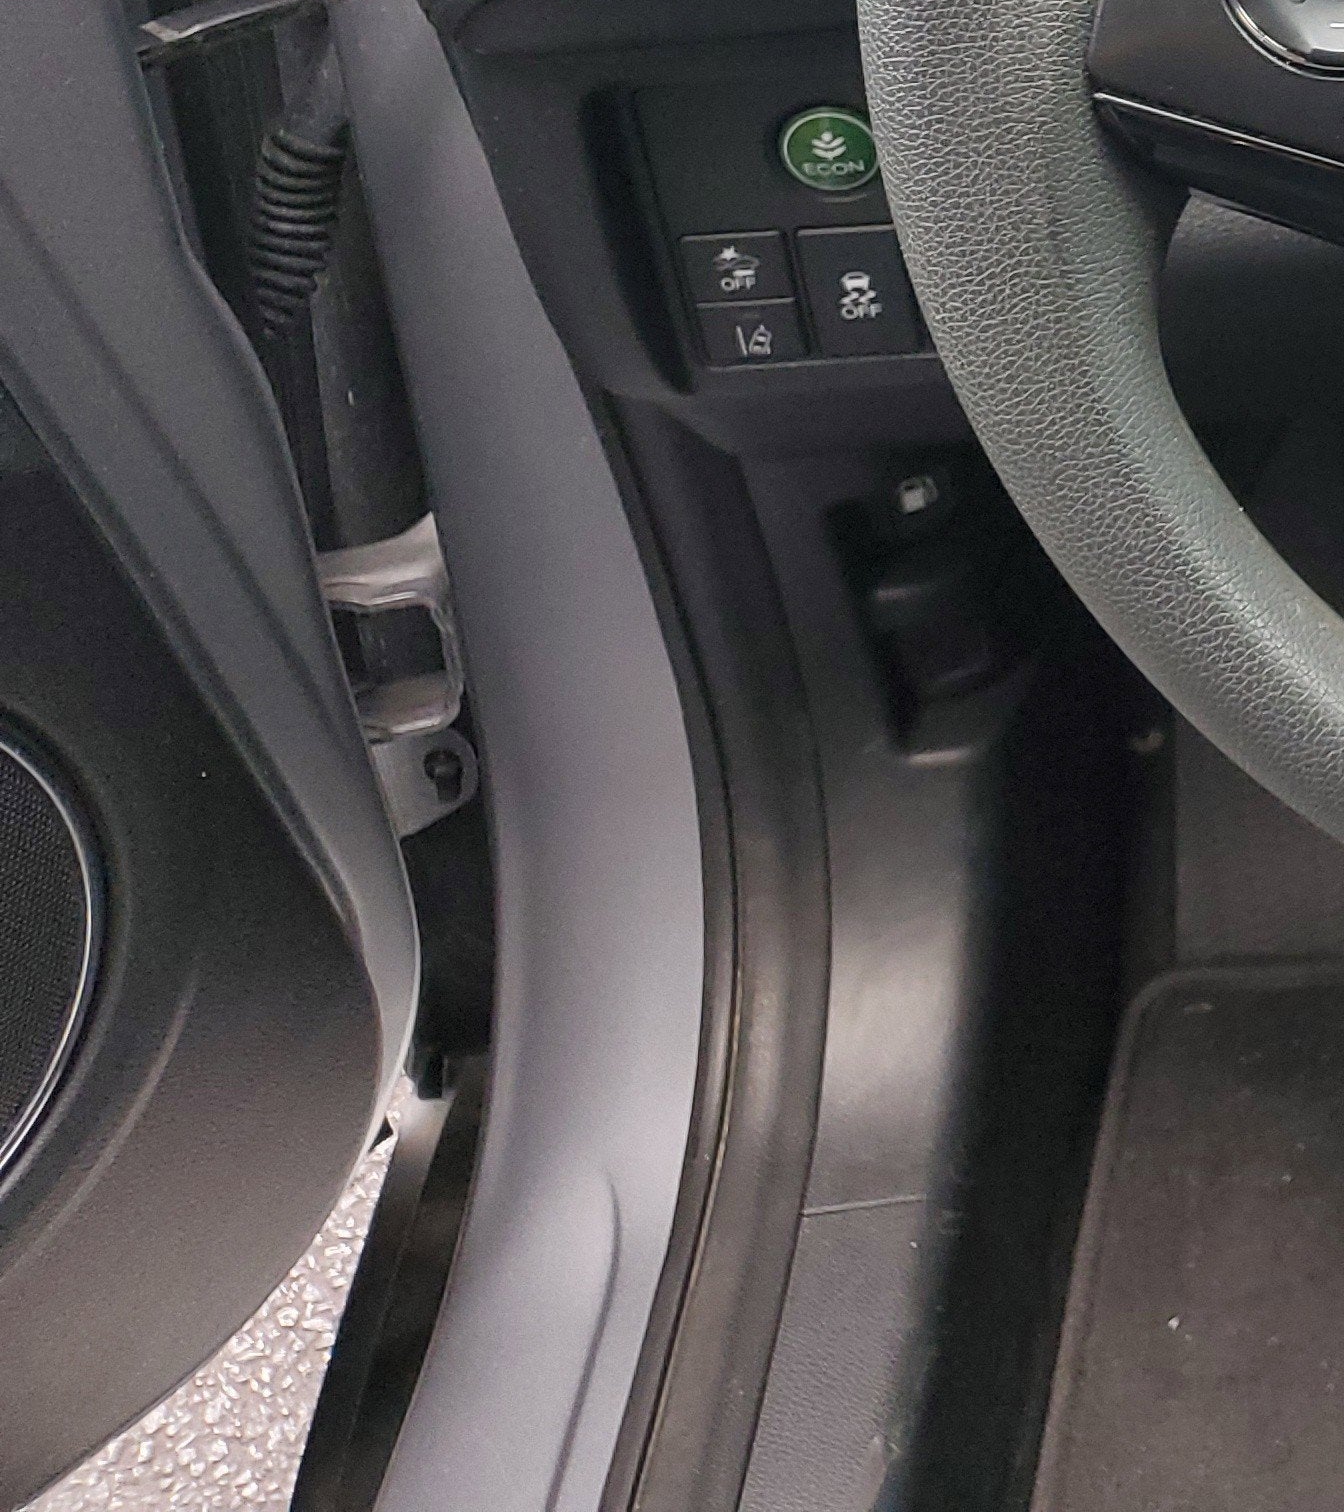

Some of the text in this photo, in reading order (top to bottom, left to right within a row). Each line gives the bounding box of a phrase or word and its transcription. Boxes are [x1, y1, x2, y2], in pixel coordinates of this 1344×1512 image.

[801, 159, 865, 176] ECON
[720, 274, 757, 292] OFF
[840, 302, 882, 319] OFF
